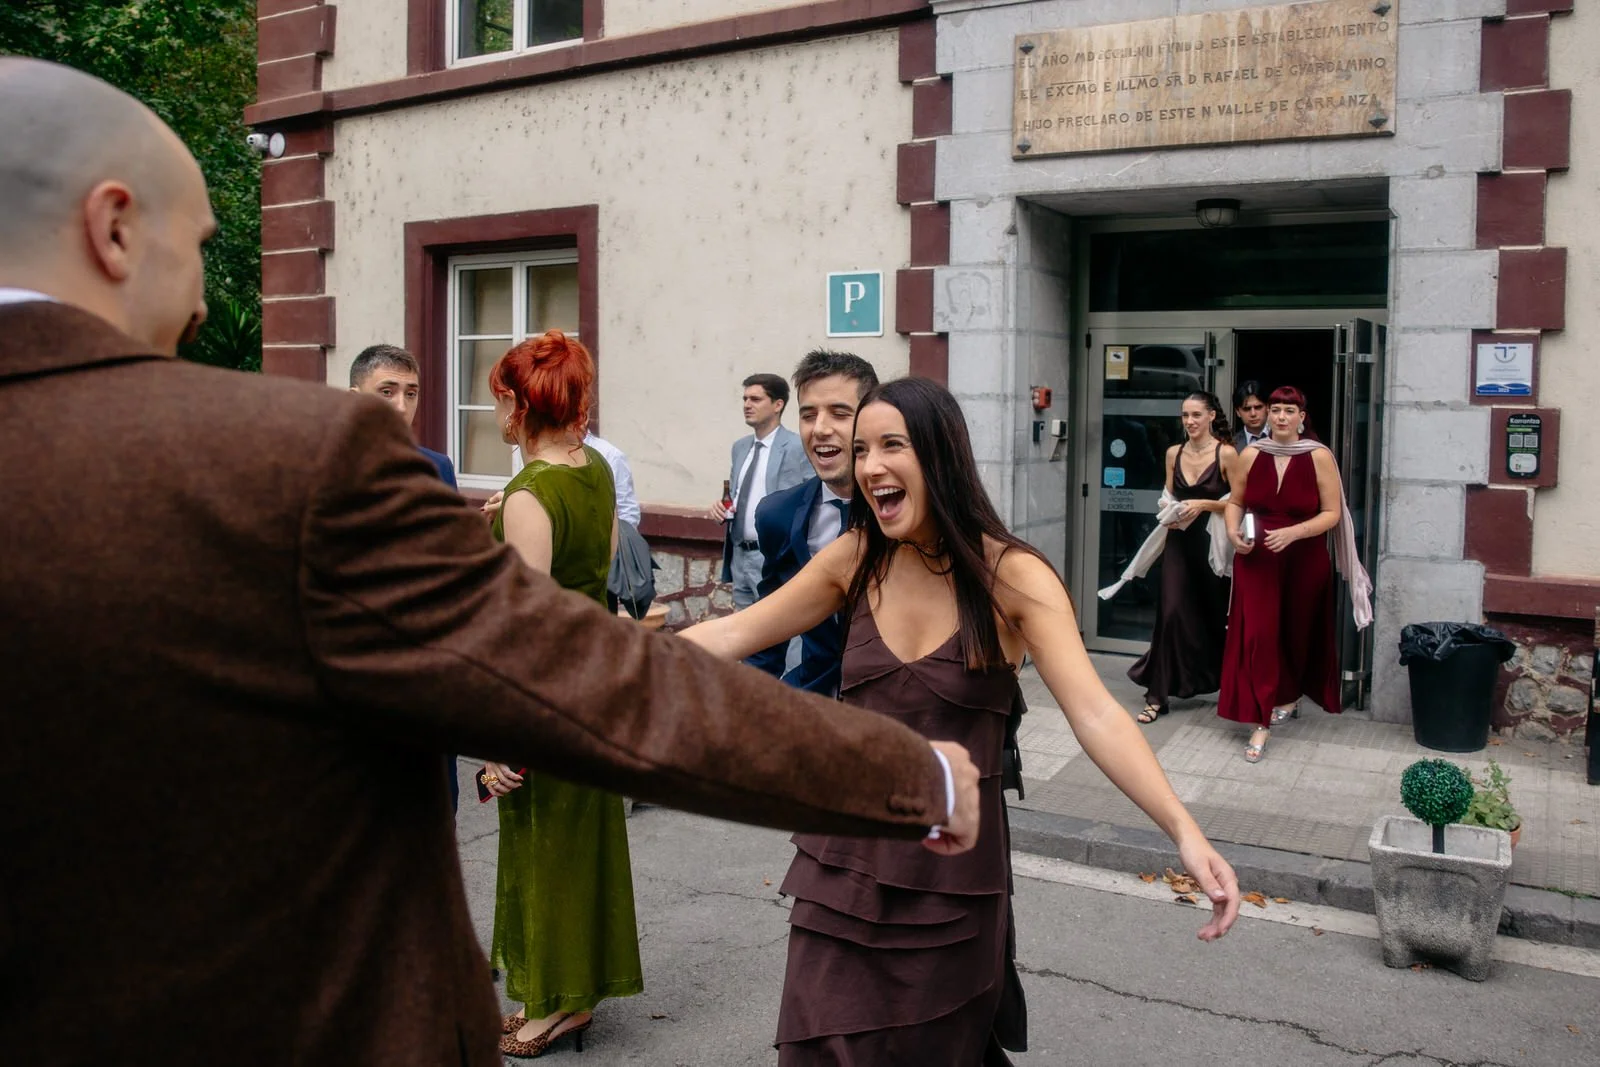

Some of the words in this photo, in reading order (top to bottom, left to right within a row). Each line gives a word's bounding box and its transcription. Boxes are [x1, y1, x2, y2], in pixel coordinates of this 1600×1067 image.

[1019, 57, 1035, 69] EL
[1041, 52, 1070, 67] AÑO
[1020, 89, 1038, 100] EL
[1046, 82, 1097, 98] EXCMO
[1203, 68, 1259, 84] RAFAEL
[1265, 66, 1282, 79] DE
[1023, 119, 1053, 132] HIJO
[1057, 112, 1130, 129] PRECLARO
[1136, 110, 1153, 122] DE
[1159, 107, 1196, 121] ESTE
[1218, 101, 1263, 116] VALLE
[1269, 100, 1289, 112] DE
[1295, 93, 1381, 111] CARRANZA
[842, 281, 866, 314] P
